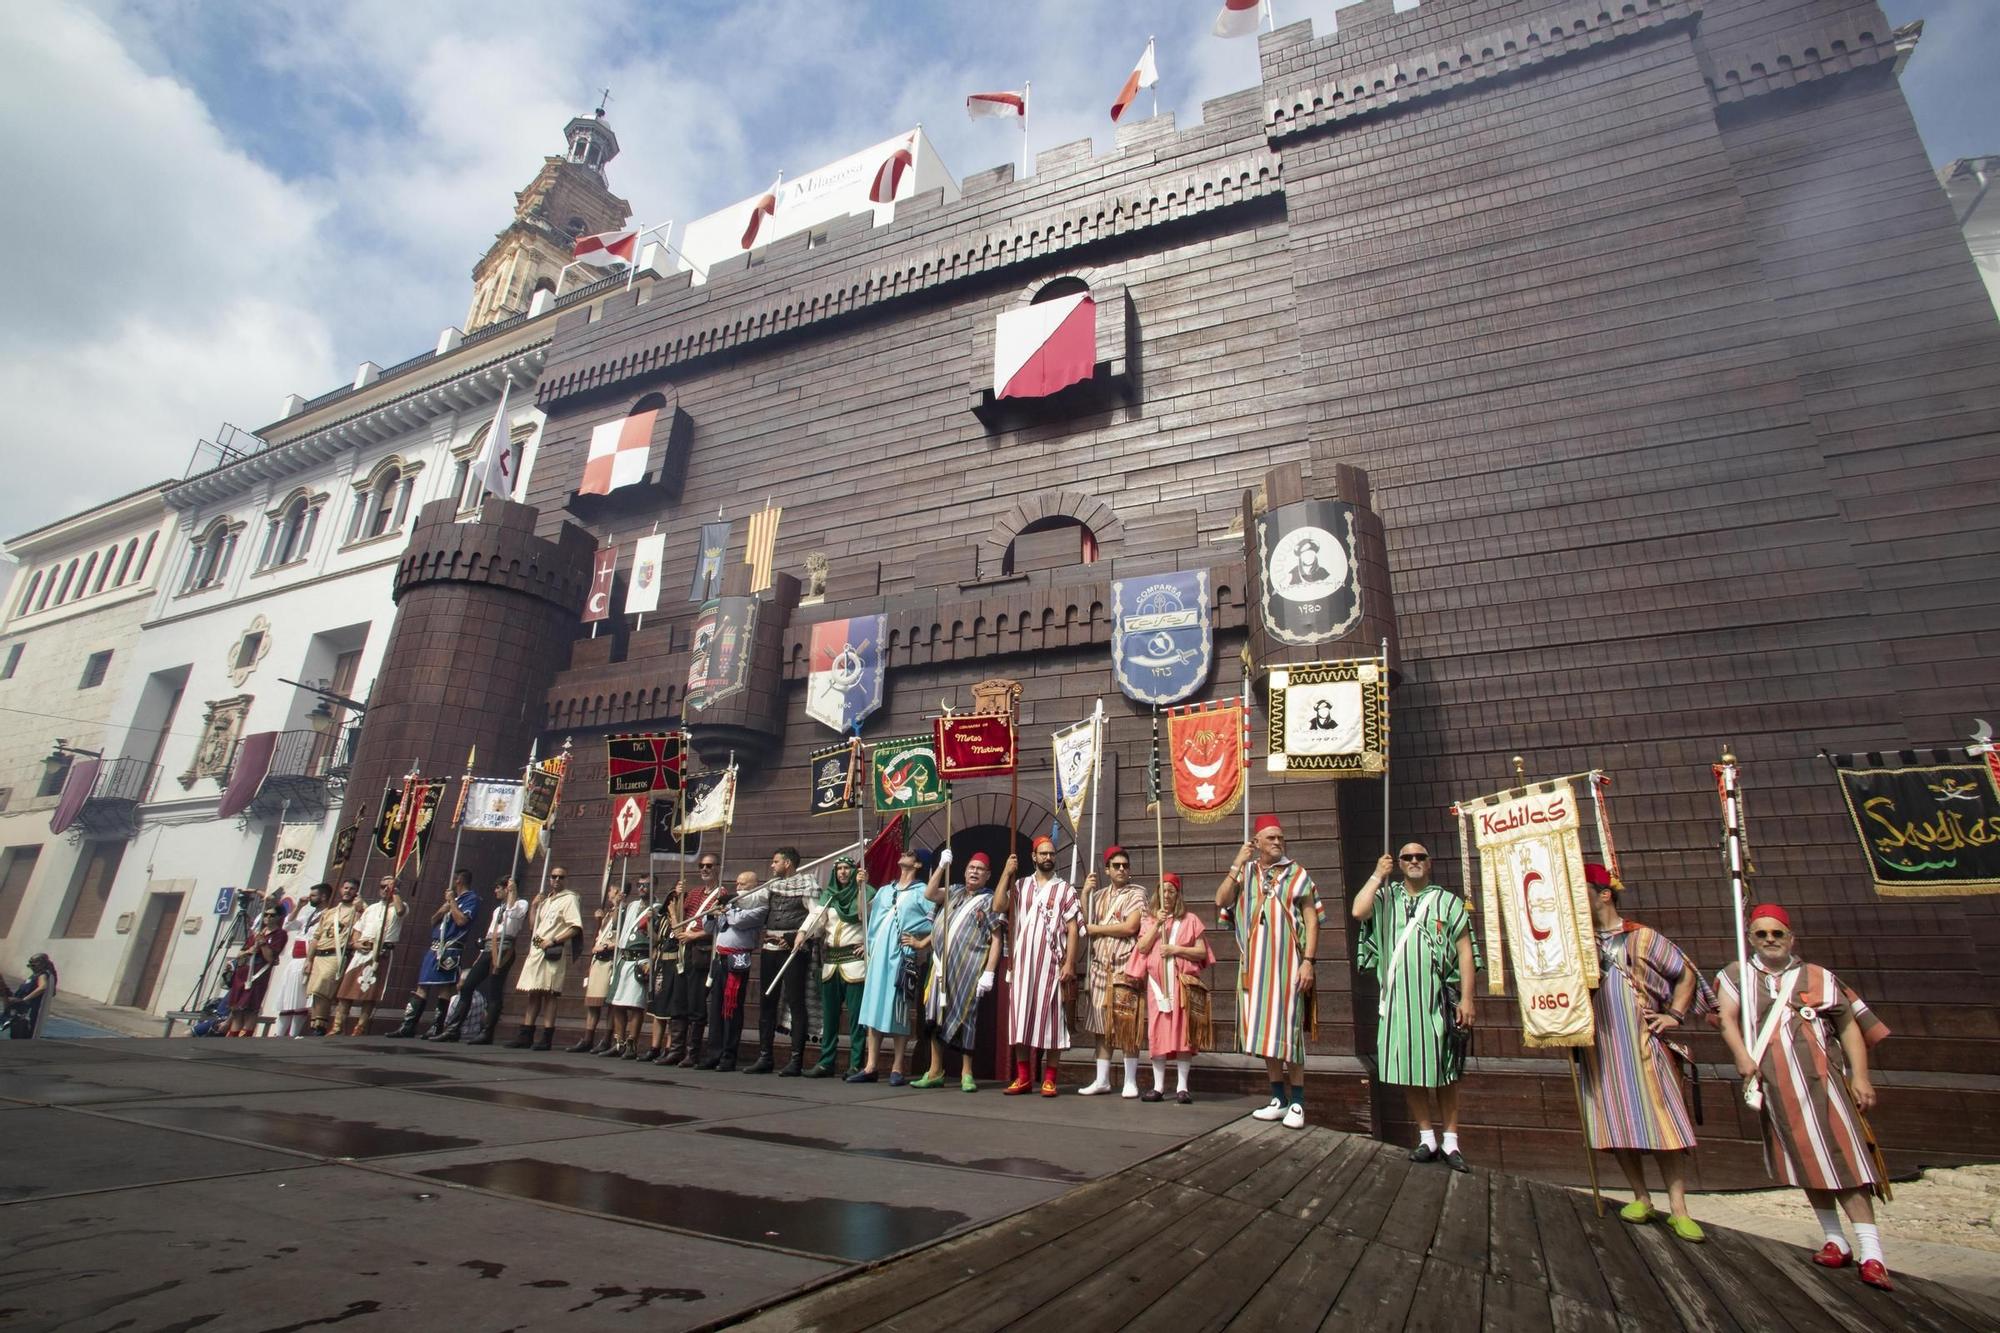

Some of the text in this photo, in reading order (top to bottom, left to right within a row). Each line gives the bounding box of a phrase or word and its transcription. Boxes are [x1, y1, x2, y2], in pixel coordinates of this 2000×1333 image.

[1136, 584, 1183, 604] COMPARSA
[955, 733, 982, 743] Moros
[971, 745, 1004, 754] Marinos
[1479, 796, 1566, 836] Kabilas
[277, 848, 306, 862] CIDES
[277, 863, 298, 874] 1976
[1530, 992, 1570, 1010] 1860
